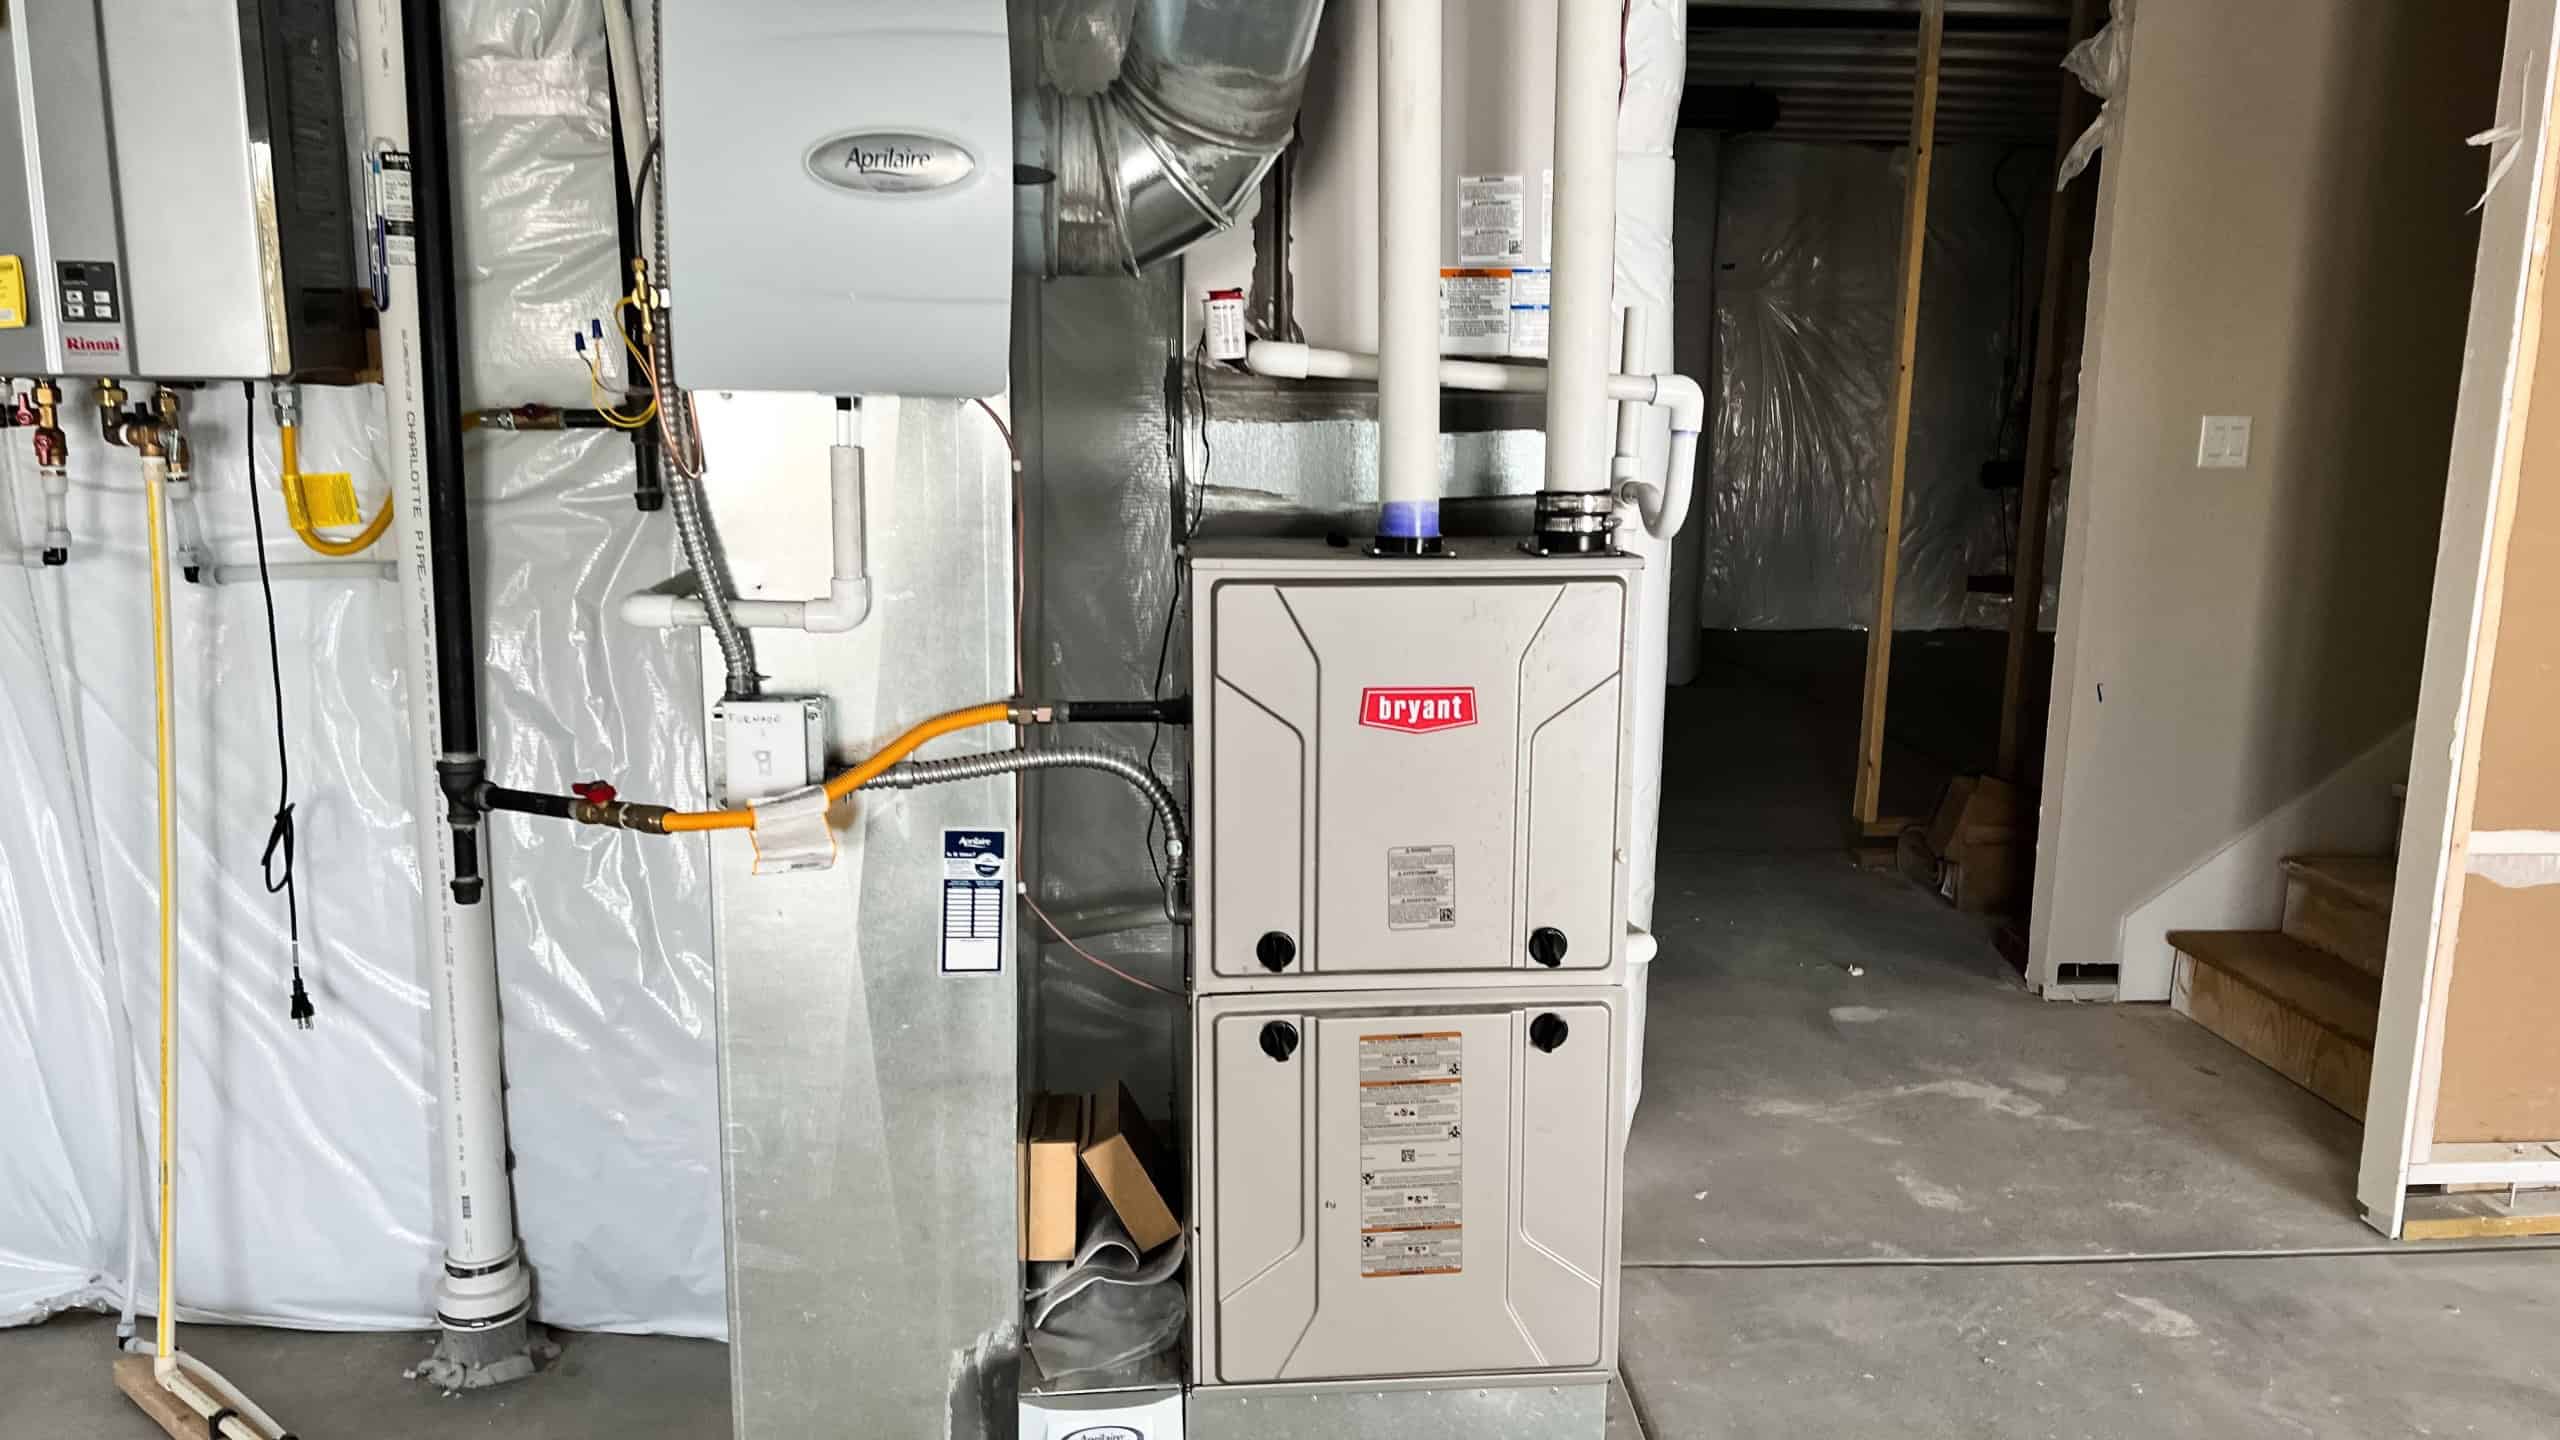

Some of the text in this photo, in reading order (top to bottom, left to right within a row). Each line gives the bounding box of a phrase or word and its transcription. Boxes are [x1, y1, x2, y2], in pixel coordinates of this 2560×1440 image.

[845, 146, 931, 174] Aprilaire
[66, 336, 120, 351] Rinnai
[406, 410, 423, 519] CHARLOTTE
[415, 530, 427, 577] PIPE
[1378, 695, 1462, 724] bryant
